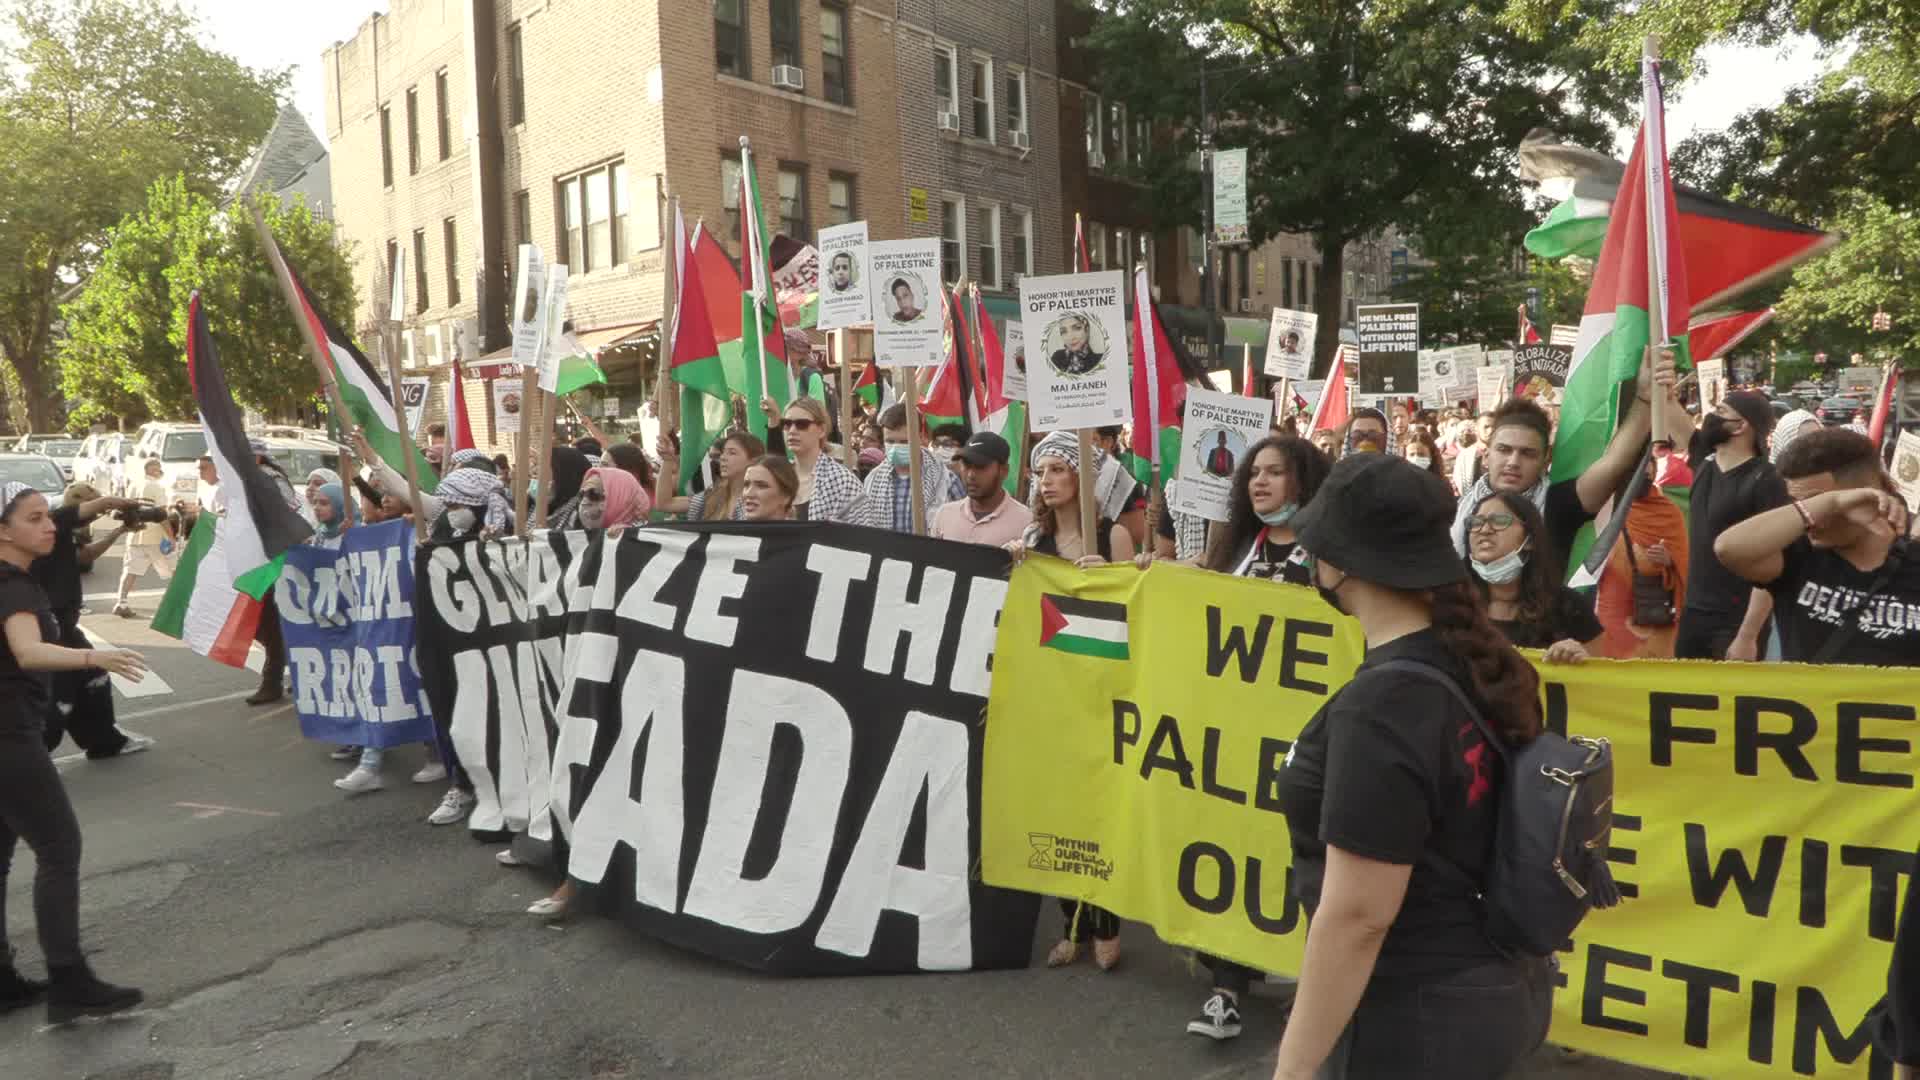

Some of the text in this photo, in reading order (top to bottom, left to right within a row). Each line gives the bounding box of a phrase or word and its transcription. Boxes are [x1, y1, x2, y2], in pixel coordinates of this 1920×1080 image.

[874, 258, 935, 271] OF PALESTINE
[1028, 286, 1117, 301] HONOR THE MARTYRS
[1029, 295, 1116, 313] OF PALESTINE
[1372, 313, 1393, 322] WILL
[1394, 313, 1417, 321] FREE
[1360, 322, 1417, 332] PALESTINE
[1360, 332, 1417, 342] WITHIN OUR
[1360, 341, 1417, 353] LIFETIME
[1515, 346, 1569, 365] GLOBALIZE
[1051, 380, 1108, 393] MAI AFANEH
[1191, 408, 1264, 429] OF PALESTINE
[1192, 402, 1216, 410] HONOR
[1231, 409, 1264, 420] MARTYRS
[805, 543, 1009, 698] THE
[1206, 604, 1334, 696] WE
[1055, 836, 1100, 854] WITHIN
[1055, 848, 1081, 861] OUR
[1054, 860, 1109, 880] LIFETIME
